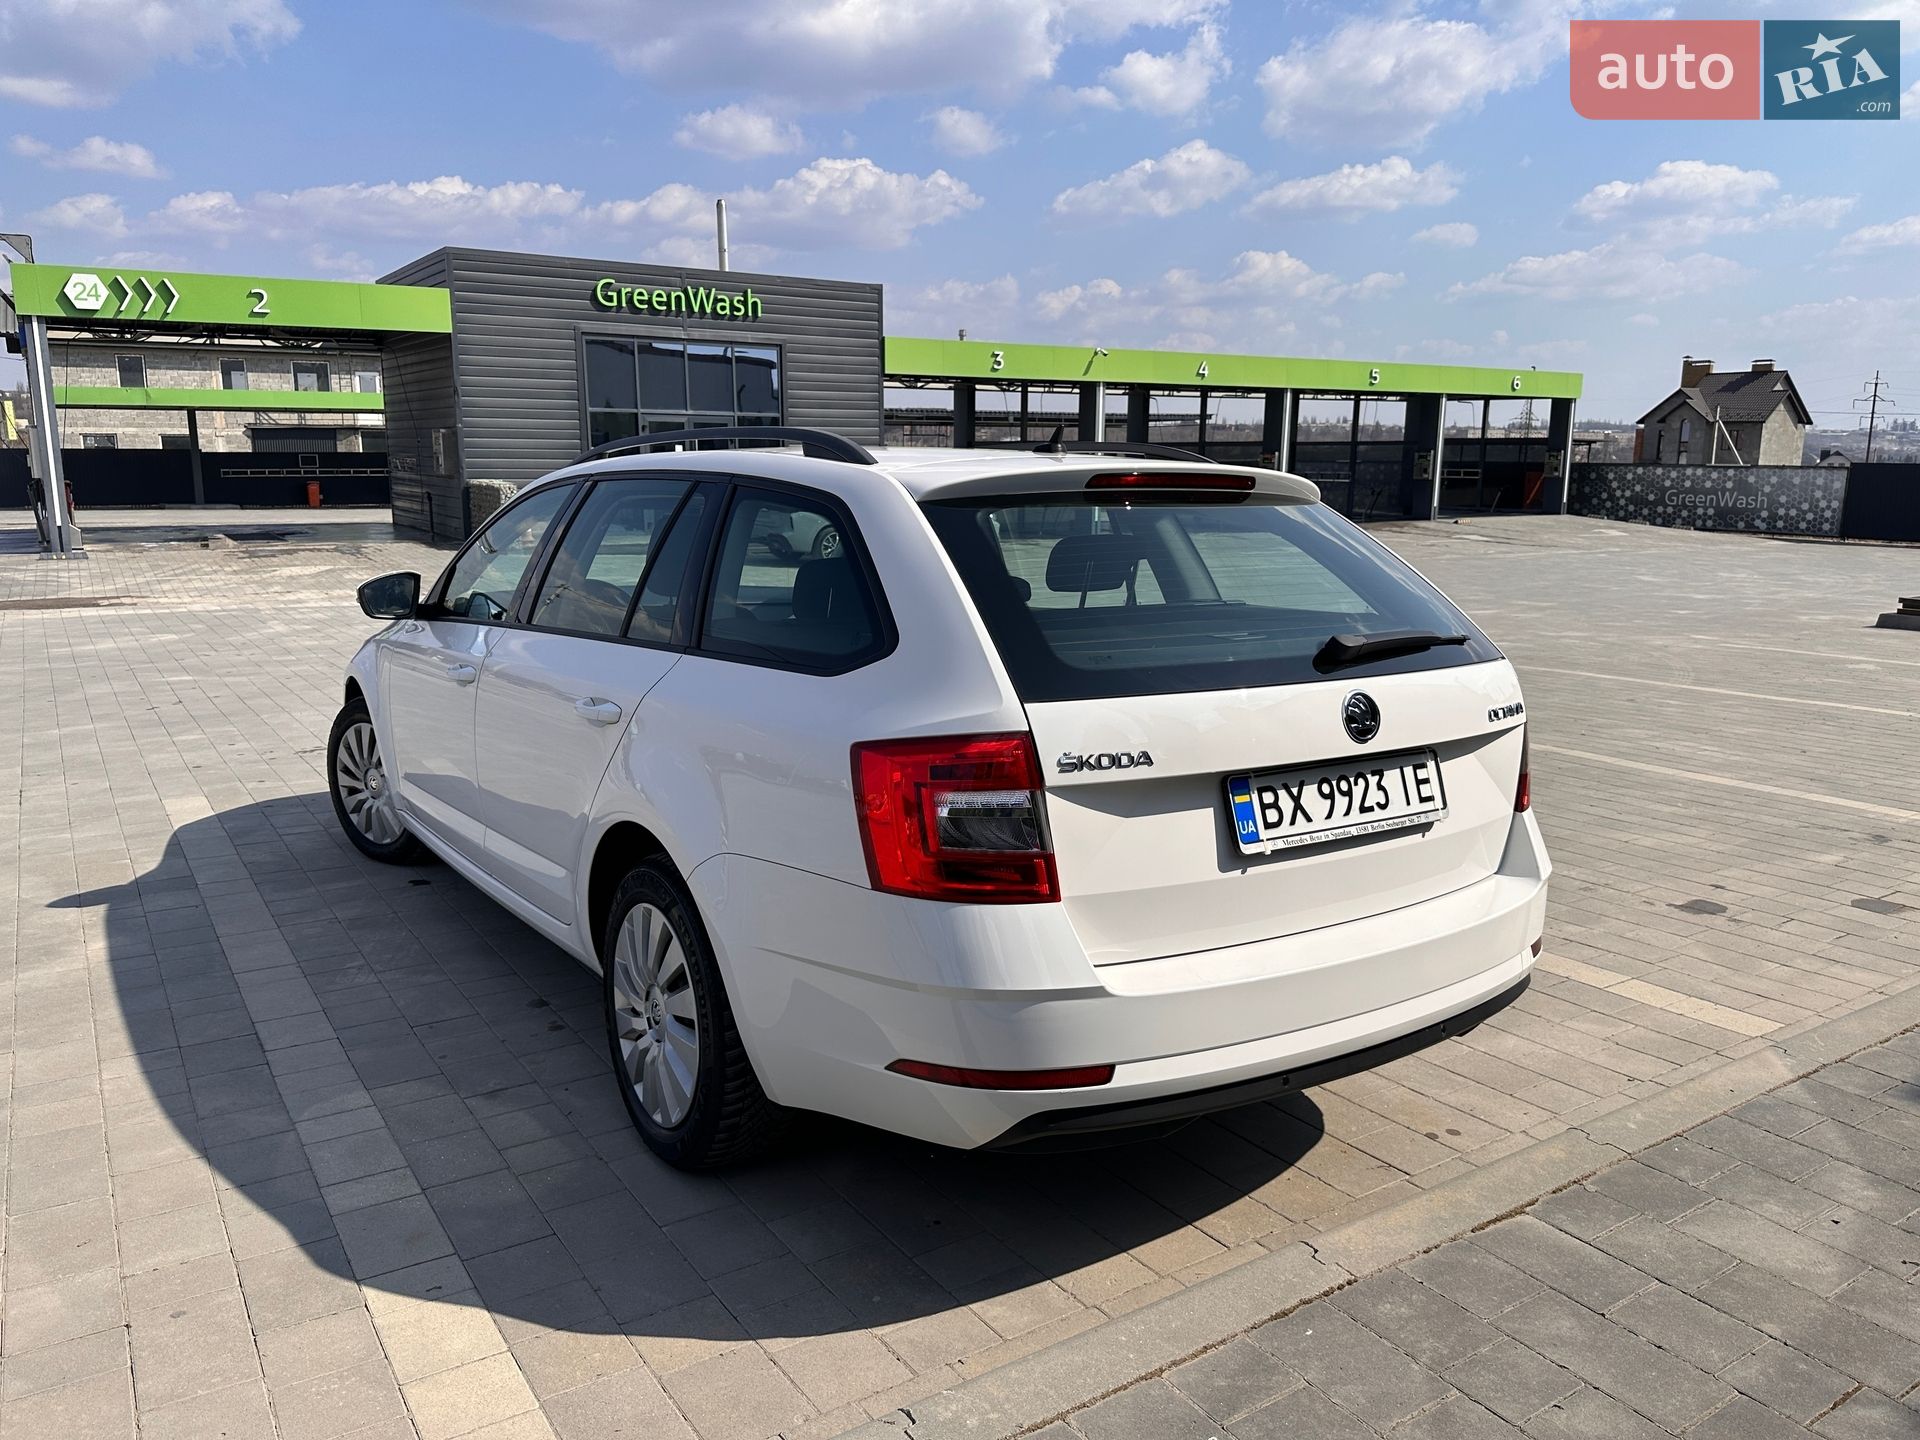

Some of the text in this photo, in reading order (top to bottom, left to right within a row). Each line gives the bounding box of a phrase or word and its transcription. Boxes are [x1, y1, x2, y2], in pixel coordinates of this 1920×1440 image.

[73, 282, 101, 301] 24
[596, 278, 762, 318] GreenWash
[250, 289, 270, 314] 2
[993, 351, 1005, 369] 3
[1198, 361, 1209, 377] 4
[1370, 369, 1380, 384] 5
[1512, 375, 1521, 390] 6
[1665, 489, 1768, 509] GreenWash
[1056, 750, 1154, 774] ŠKODA
[1256, 762, 1435, 830] BX 9923 IE
[1239, 819, 1256, 834] UA
[1282, 836, 1308, 847] Mercedes
